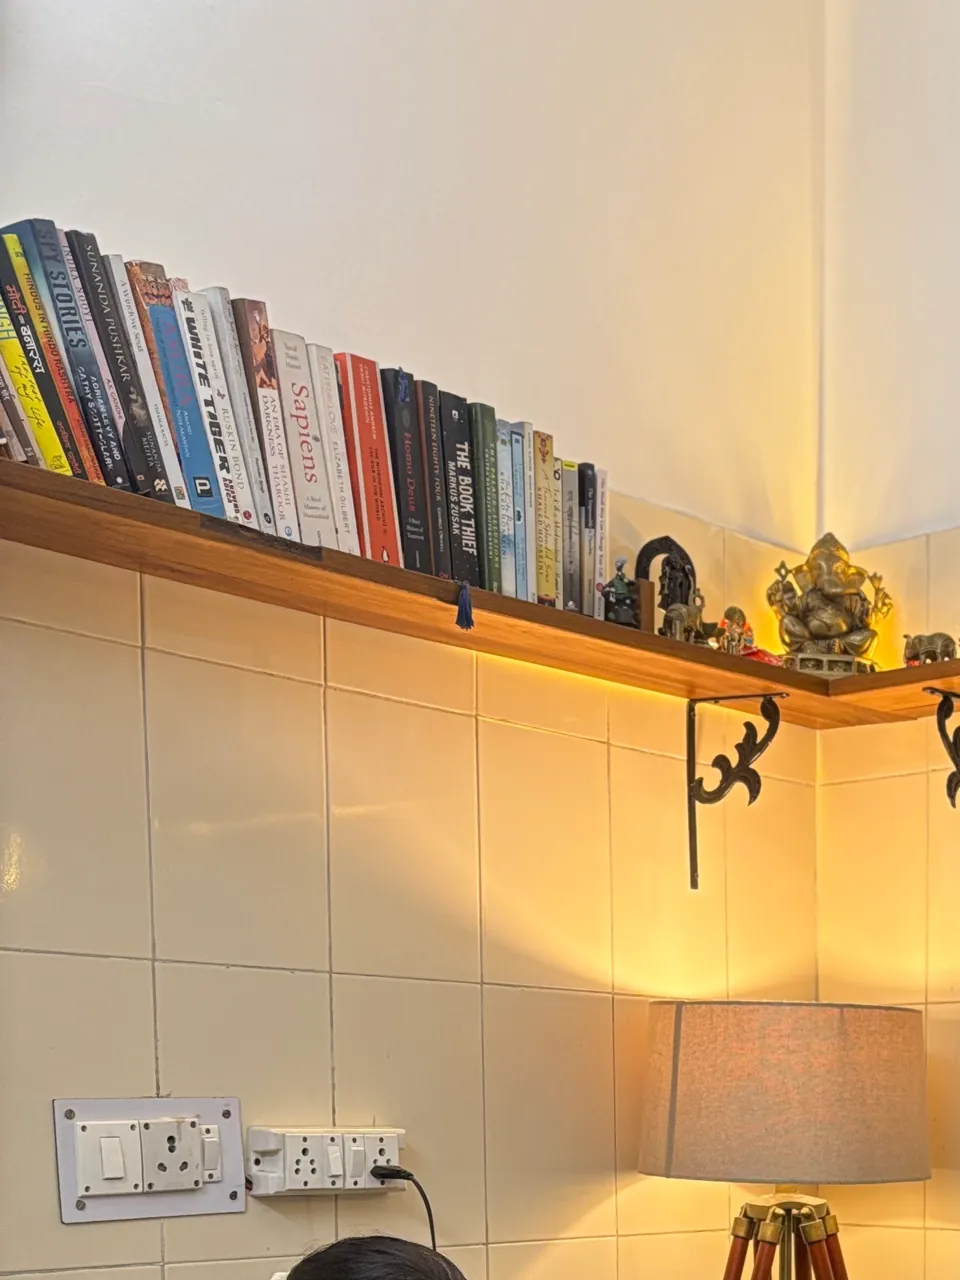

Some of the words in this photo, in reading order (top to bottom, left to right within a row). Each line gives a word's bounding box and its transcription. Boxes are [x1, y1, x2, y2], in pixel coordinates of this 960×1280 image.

[38, 229, 62, 263] SPY
[24, 272, 42, 311] HINDUS
[48, 270, 87, 348] STORIES
[37, 313, 48, 324] IN
[84, 243, 111, 314] SUNANDA
[105, 317, 131, 383] PUSHKAR
[42, 325, 60, 360] HINDU
[54, 359, 76, 404] RASHTRA
[79, 366, 94, 400] CATHY
[185, 316, 211, 389] WHITE
[204, 394, 230, 475] TIGER
[262, 395, 276, 457] DARKNESS
[268, 396, 278, 412] AN
[273, 414, 281, 439] ERA
[290, 382, 318, 484] Sapiens
[428, 395, 438, 439] NINETEEN
[109, 441, 121, 460] AND
[221, 408, 238, 452] RUSKIN
[232, 456, 245, 490] BOND
[404, 432, 413, 478] Homo
[431, 441, 440, 475] EIGHTY
[455, 442, 471, 470] THE
[227, 478, 241, 514] ARAVIND
[272, 464, 286, 521] THAROOR
[280, 463, 291, 506] SHASHI
[333, 441, 345, 492] ELIZABETH
[340, 495, 350, 534] GILBERT
[407, 478, 417, 512] Deus
[434, 477, 442, 502] FOUR
[447, 460, 458, 502] MARKUS
[458, 473, 474, 514] BOOK
[451, 503, 461, 536] ZUSAK
[461, 517, 478, 556] THIEF
